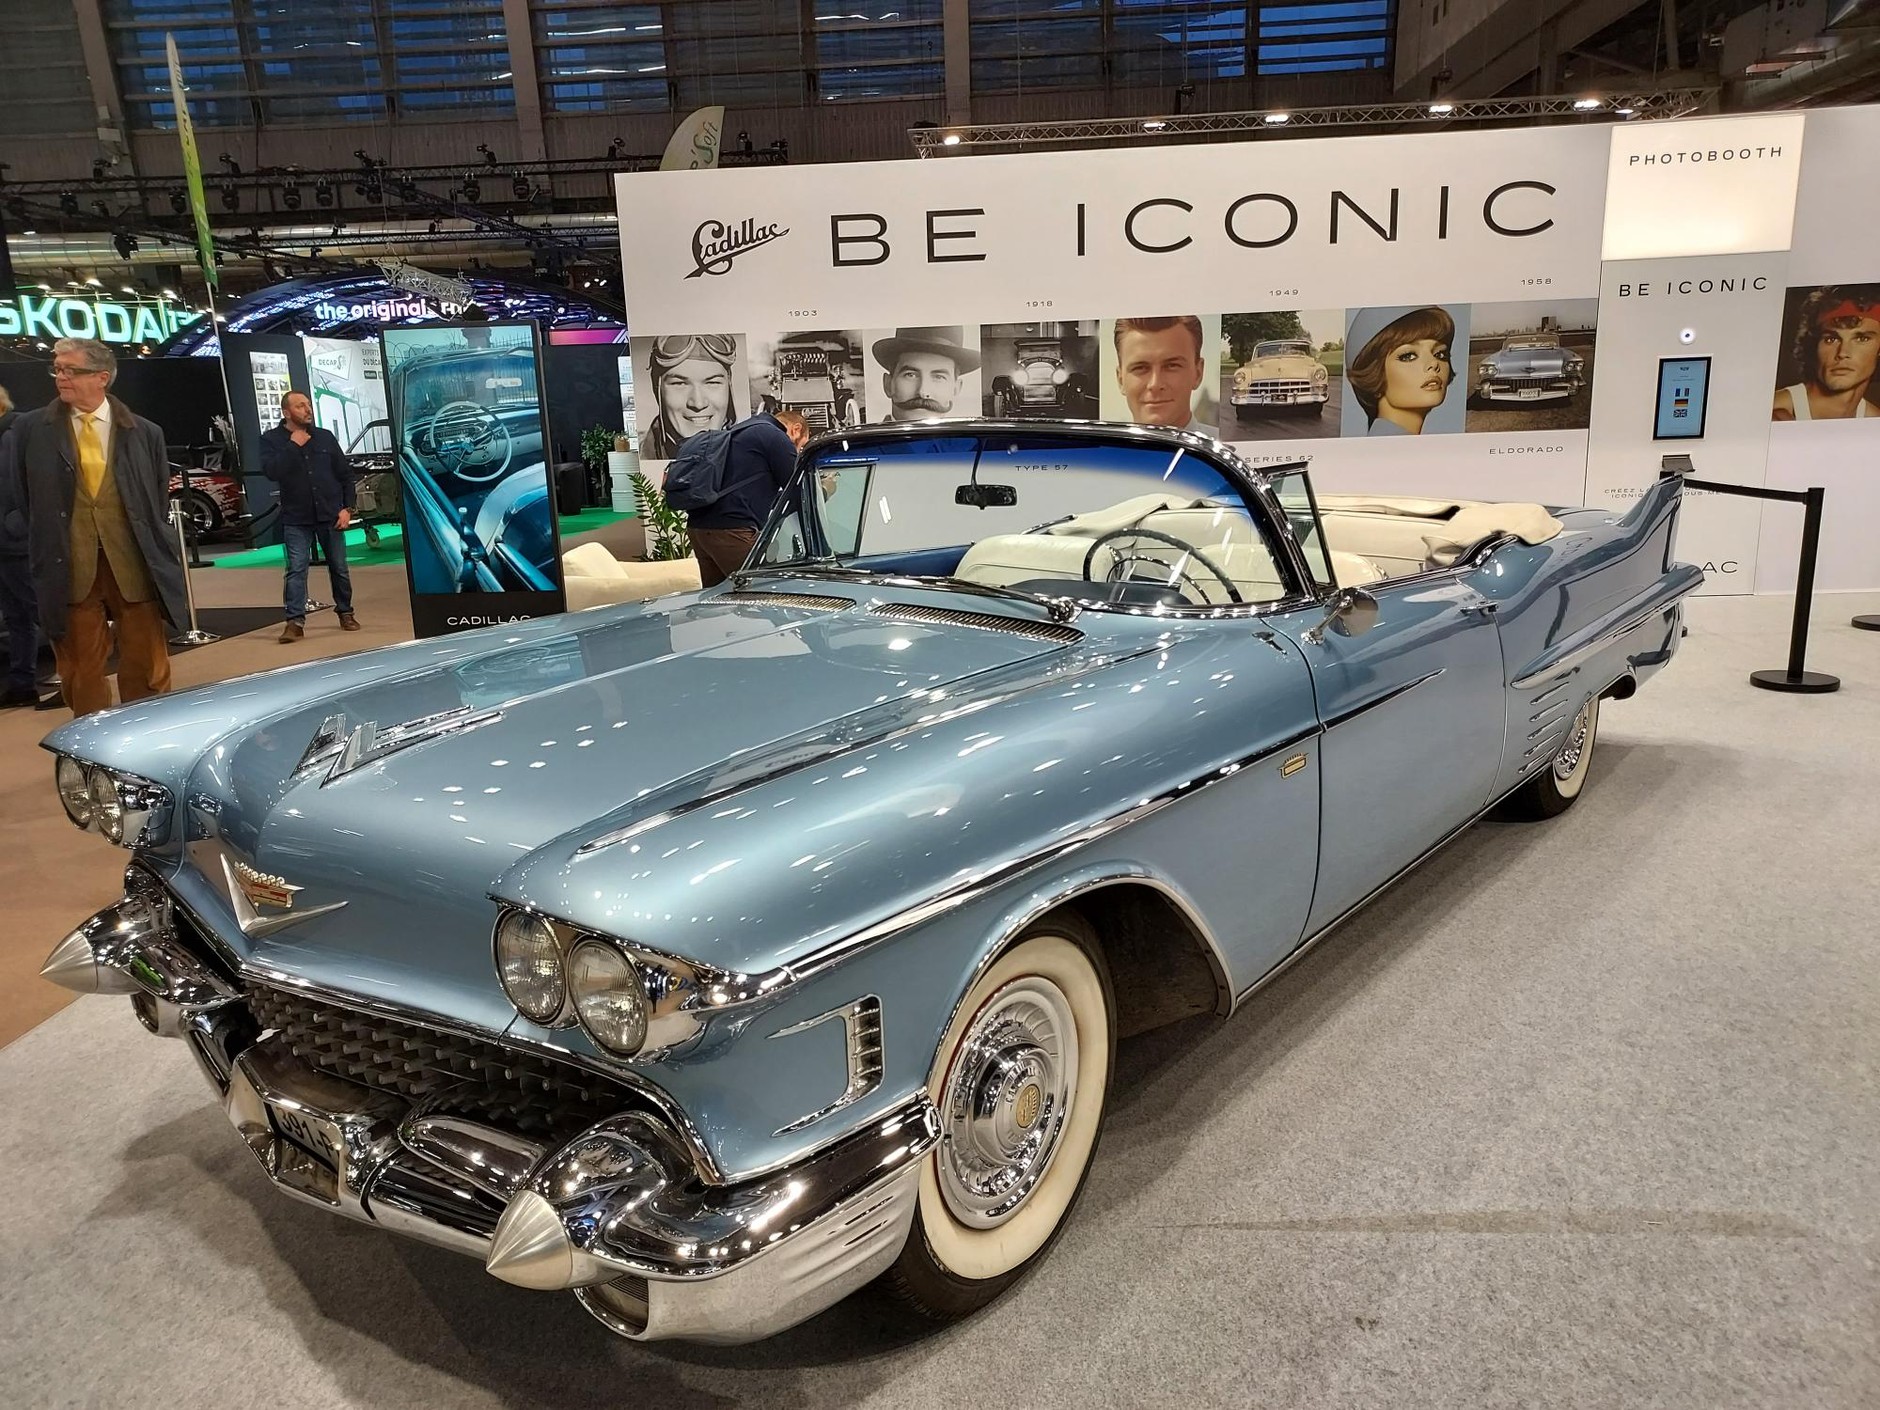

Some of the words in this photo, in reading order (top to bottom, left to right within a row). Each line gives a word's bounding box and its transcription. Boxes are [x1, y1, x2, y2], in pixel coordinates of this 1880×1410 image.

[1629, 146, 1783, 166] PHOTOBOOTH
[830, 208, 987, 268] BE
[1077, 180, 1557, 257] ICONIC
[684, 217, 790, 280] Cadillac
[1520, 278, 1553, 286] 1958
[1619, 284, 1650, 297] BE
[1667, 276, 1768, 295] ICONIC
[1268, 289, 1300, 297] 1949
[1025, 300, 1054, 308] 1918
[315, 301, 348, 319] the
[351, 299, 426, 321] original
[788, 309, 818, 317] 1903
[1489, 445, 1564, 455] ELDORADO
[1244, 456, 1293, 464] SERIES
[447, 615, 531, 626] CADILLAC
